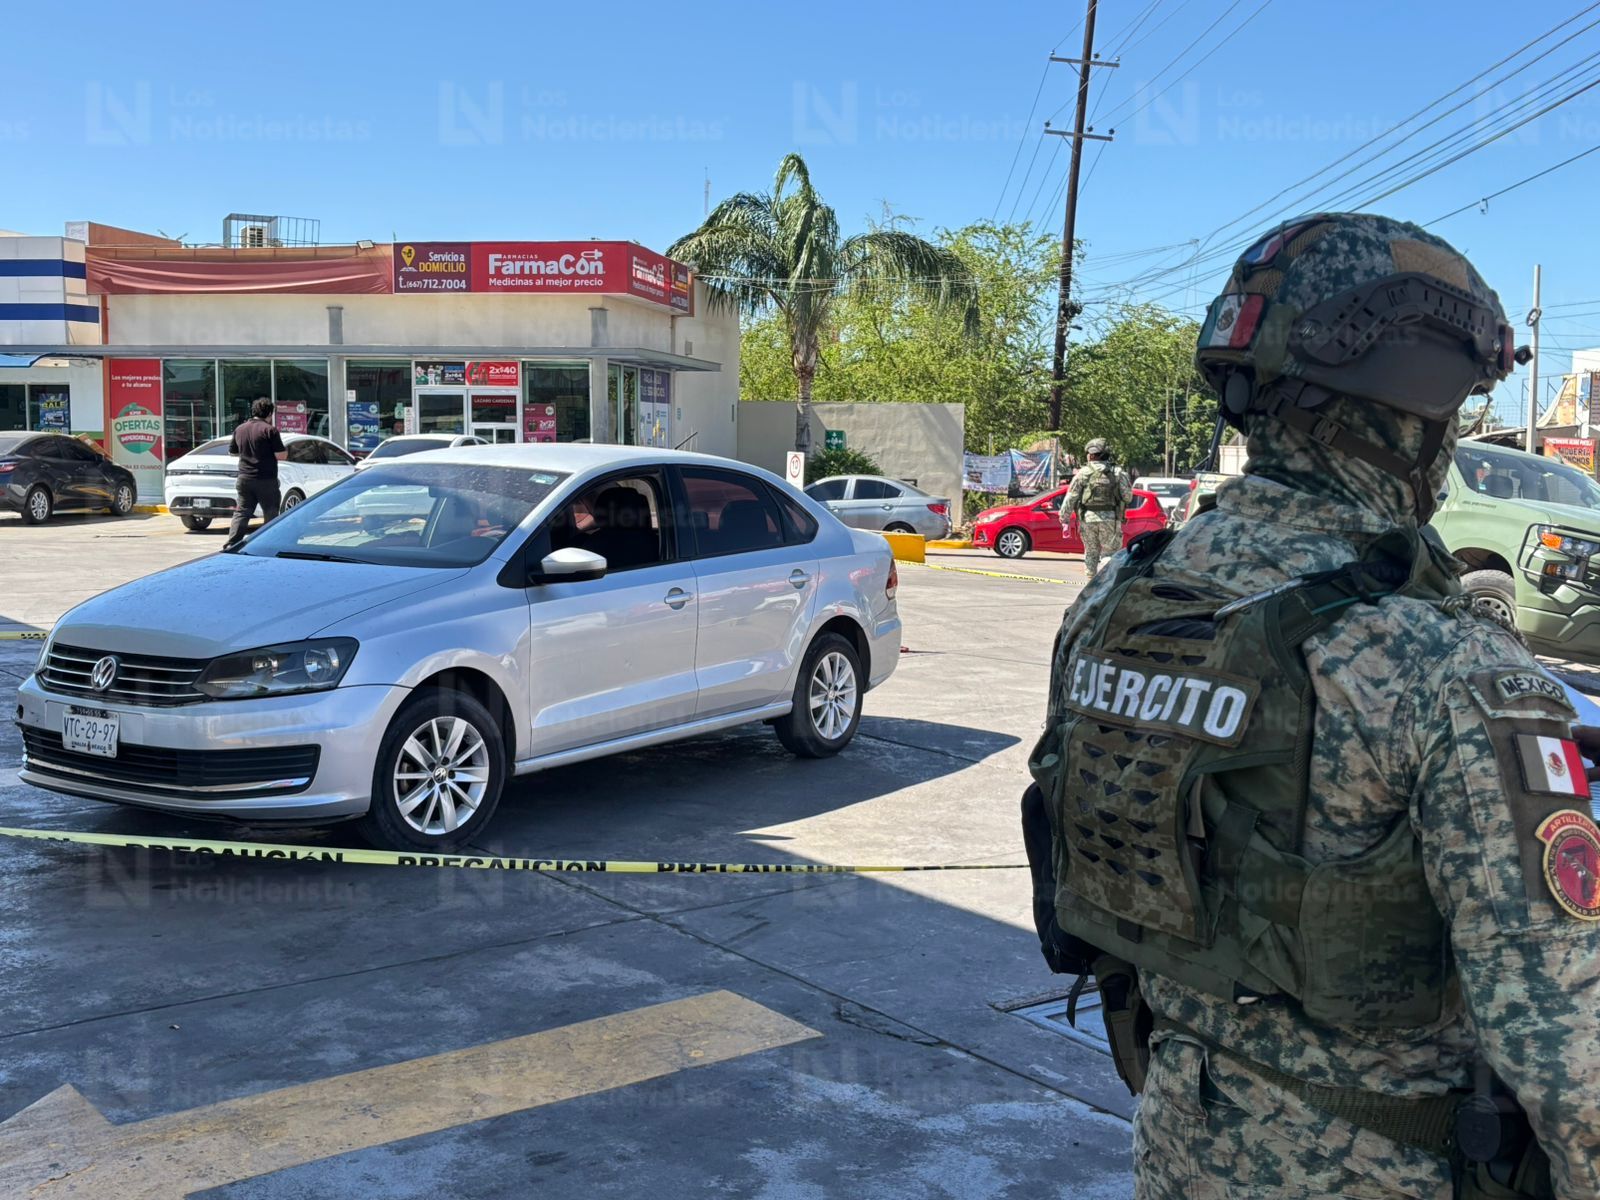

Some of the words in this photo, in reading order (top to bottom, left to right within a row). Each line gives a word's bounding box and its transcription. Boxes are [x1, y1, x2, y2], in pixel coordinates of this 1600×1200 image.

[429, 252, 458, 262] Servicio
[459, 254, 465, 262] a
[419, 262, 466, 272] DOMICILIO
[489, 278, 533, 286] Medicinas
[535, 278, 543, 286] al
[546, 278, 572, 287] mejor
[575, 278, 603, 287] precio
[114, 420, 160, 432] OFERTAS
[1501, 673, 1564, 700] MÉXICO
[1070, 658, 1247, 738] EJÉRCITO
[63, 717, 116, 743] VTC-29-97
